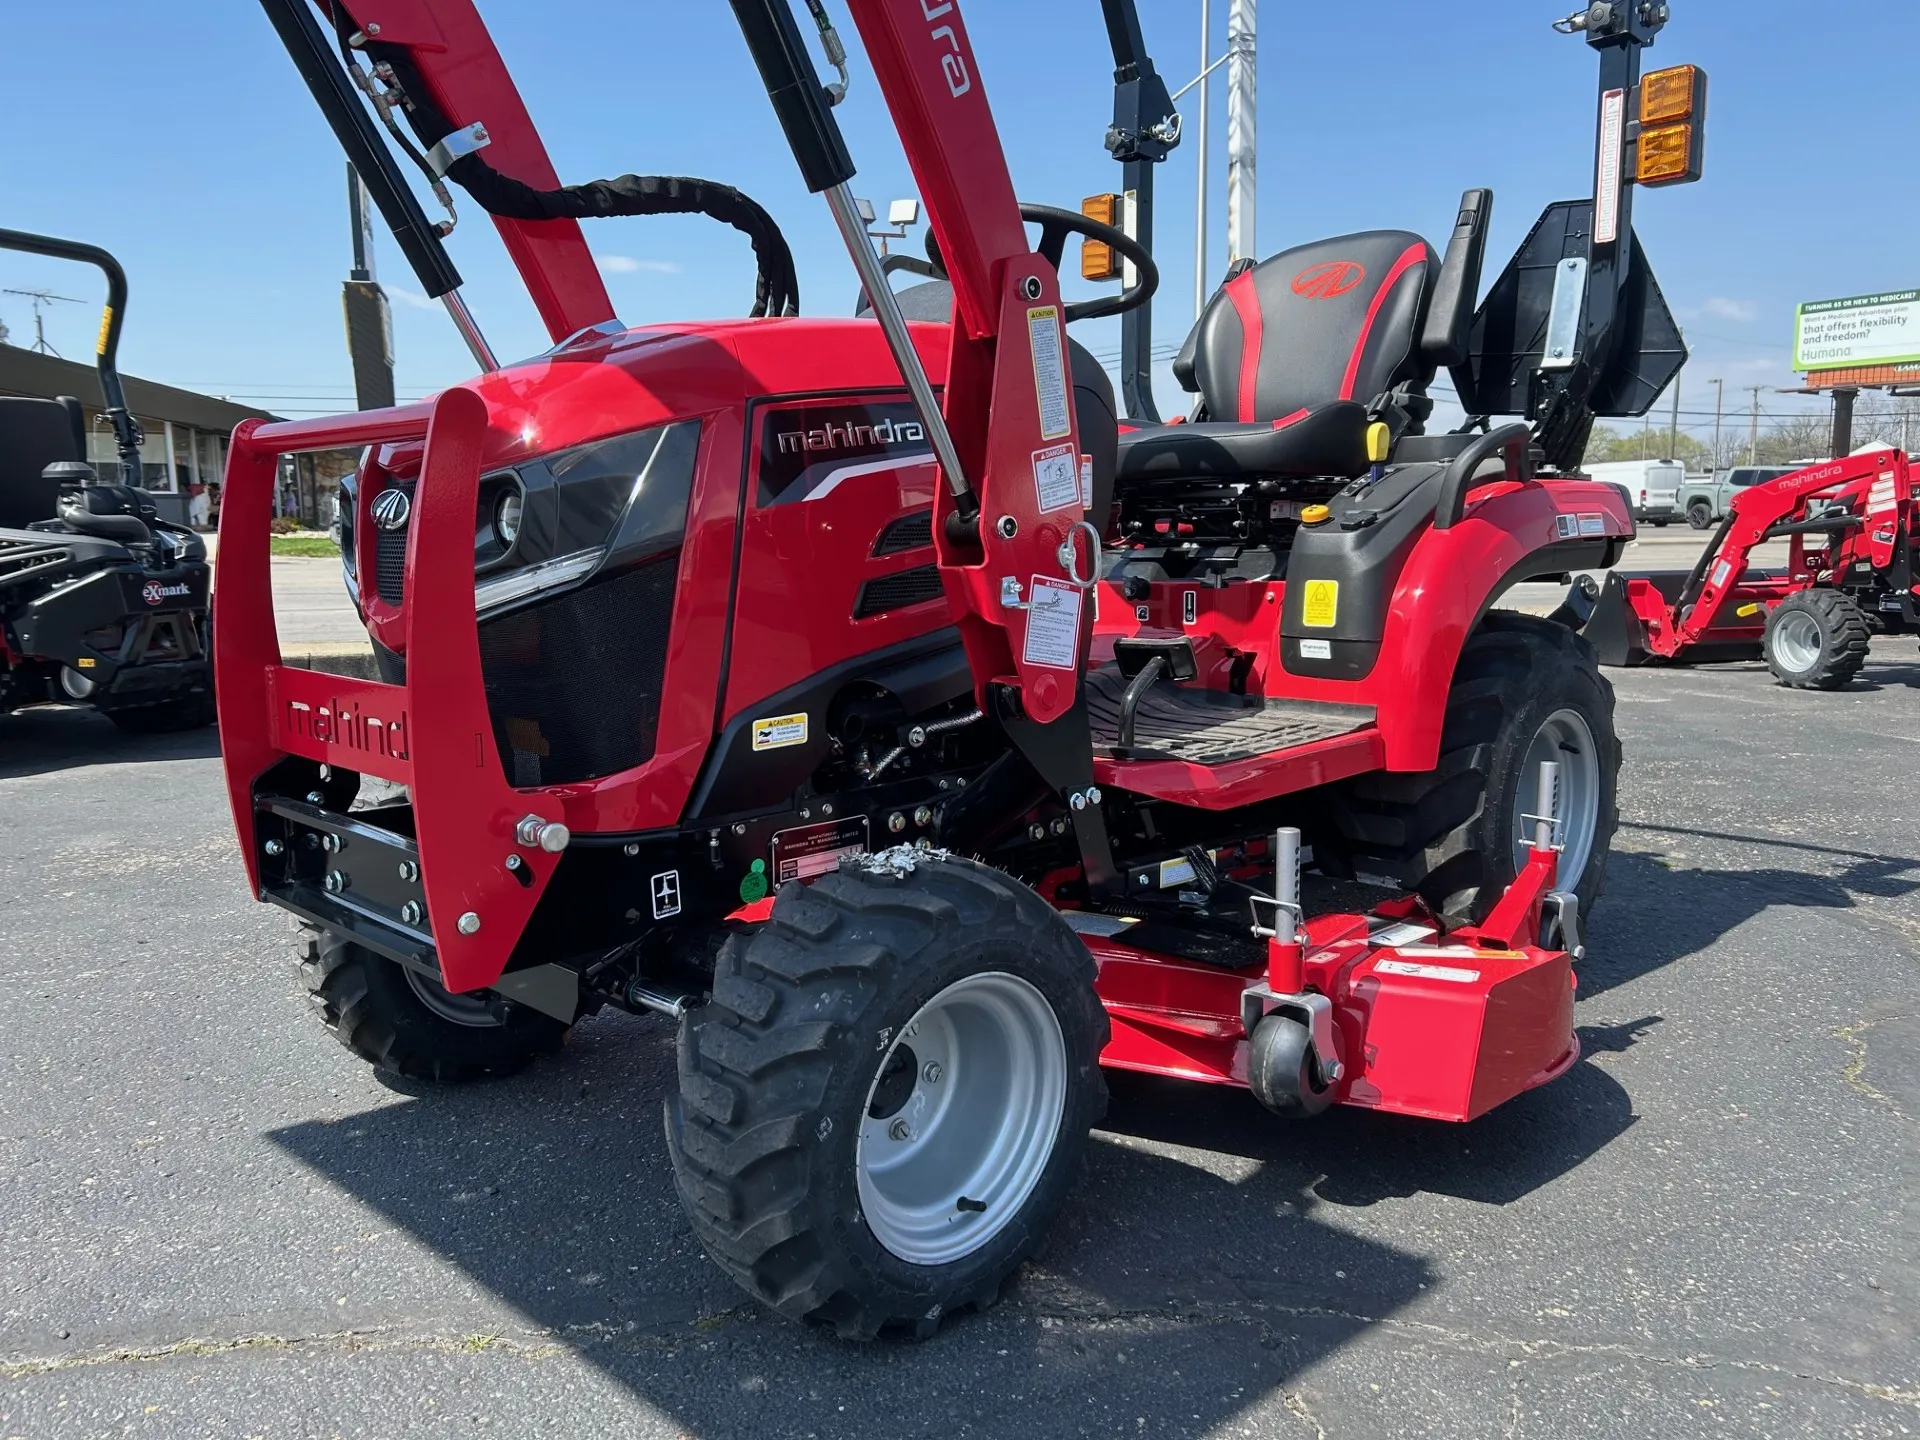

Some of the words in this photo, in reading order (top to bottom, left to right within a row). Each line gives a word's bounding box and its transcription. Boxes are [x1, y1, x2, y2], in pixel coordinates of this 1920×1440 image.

[1805, 302, 1832, 311] TURNING
[1853, 298, 1868, 306] NEW
[1880, 292, 1916, 302] MEDICARE?
[1035, 309, 1054, 318] CAUTION
[1828, 312, 1856, 320] Medicare
[1858, 307, 1892, 317] Advantage
[1893, 305, 1908, 314] plan
[1804, 323, 1824, 334] that
[1827, 321, 1856, 332] offers
[1859, 316, 1908, 328] flexibility
[1803, 335, 1821, 345] and
[1824, 329, 1871, 342] freedom?
[1801, 347, 1851, 361] Humana
[777, 418, 924, 453] mahindra
[1045, 447, 1067, 459] DANGER
[1778, 465, 1843, 491] mahindra
[1050, 581, 1070, 590] DANGER
[772, 717, 794, 727] CAUTION
[784, 841, 809, 850] MAHINDRA
[817, 835, 840, 844] MAHINDRA
